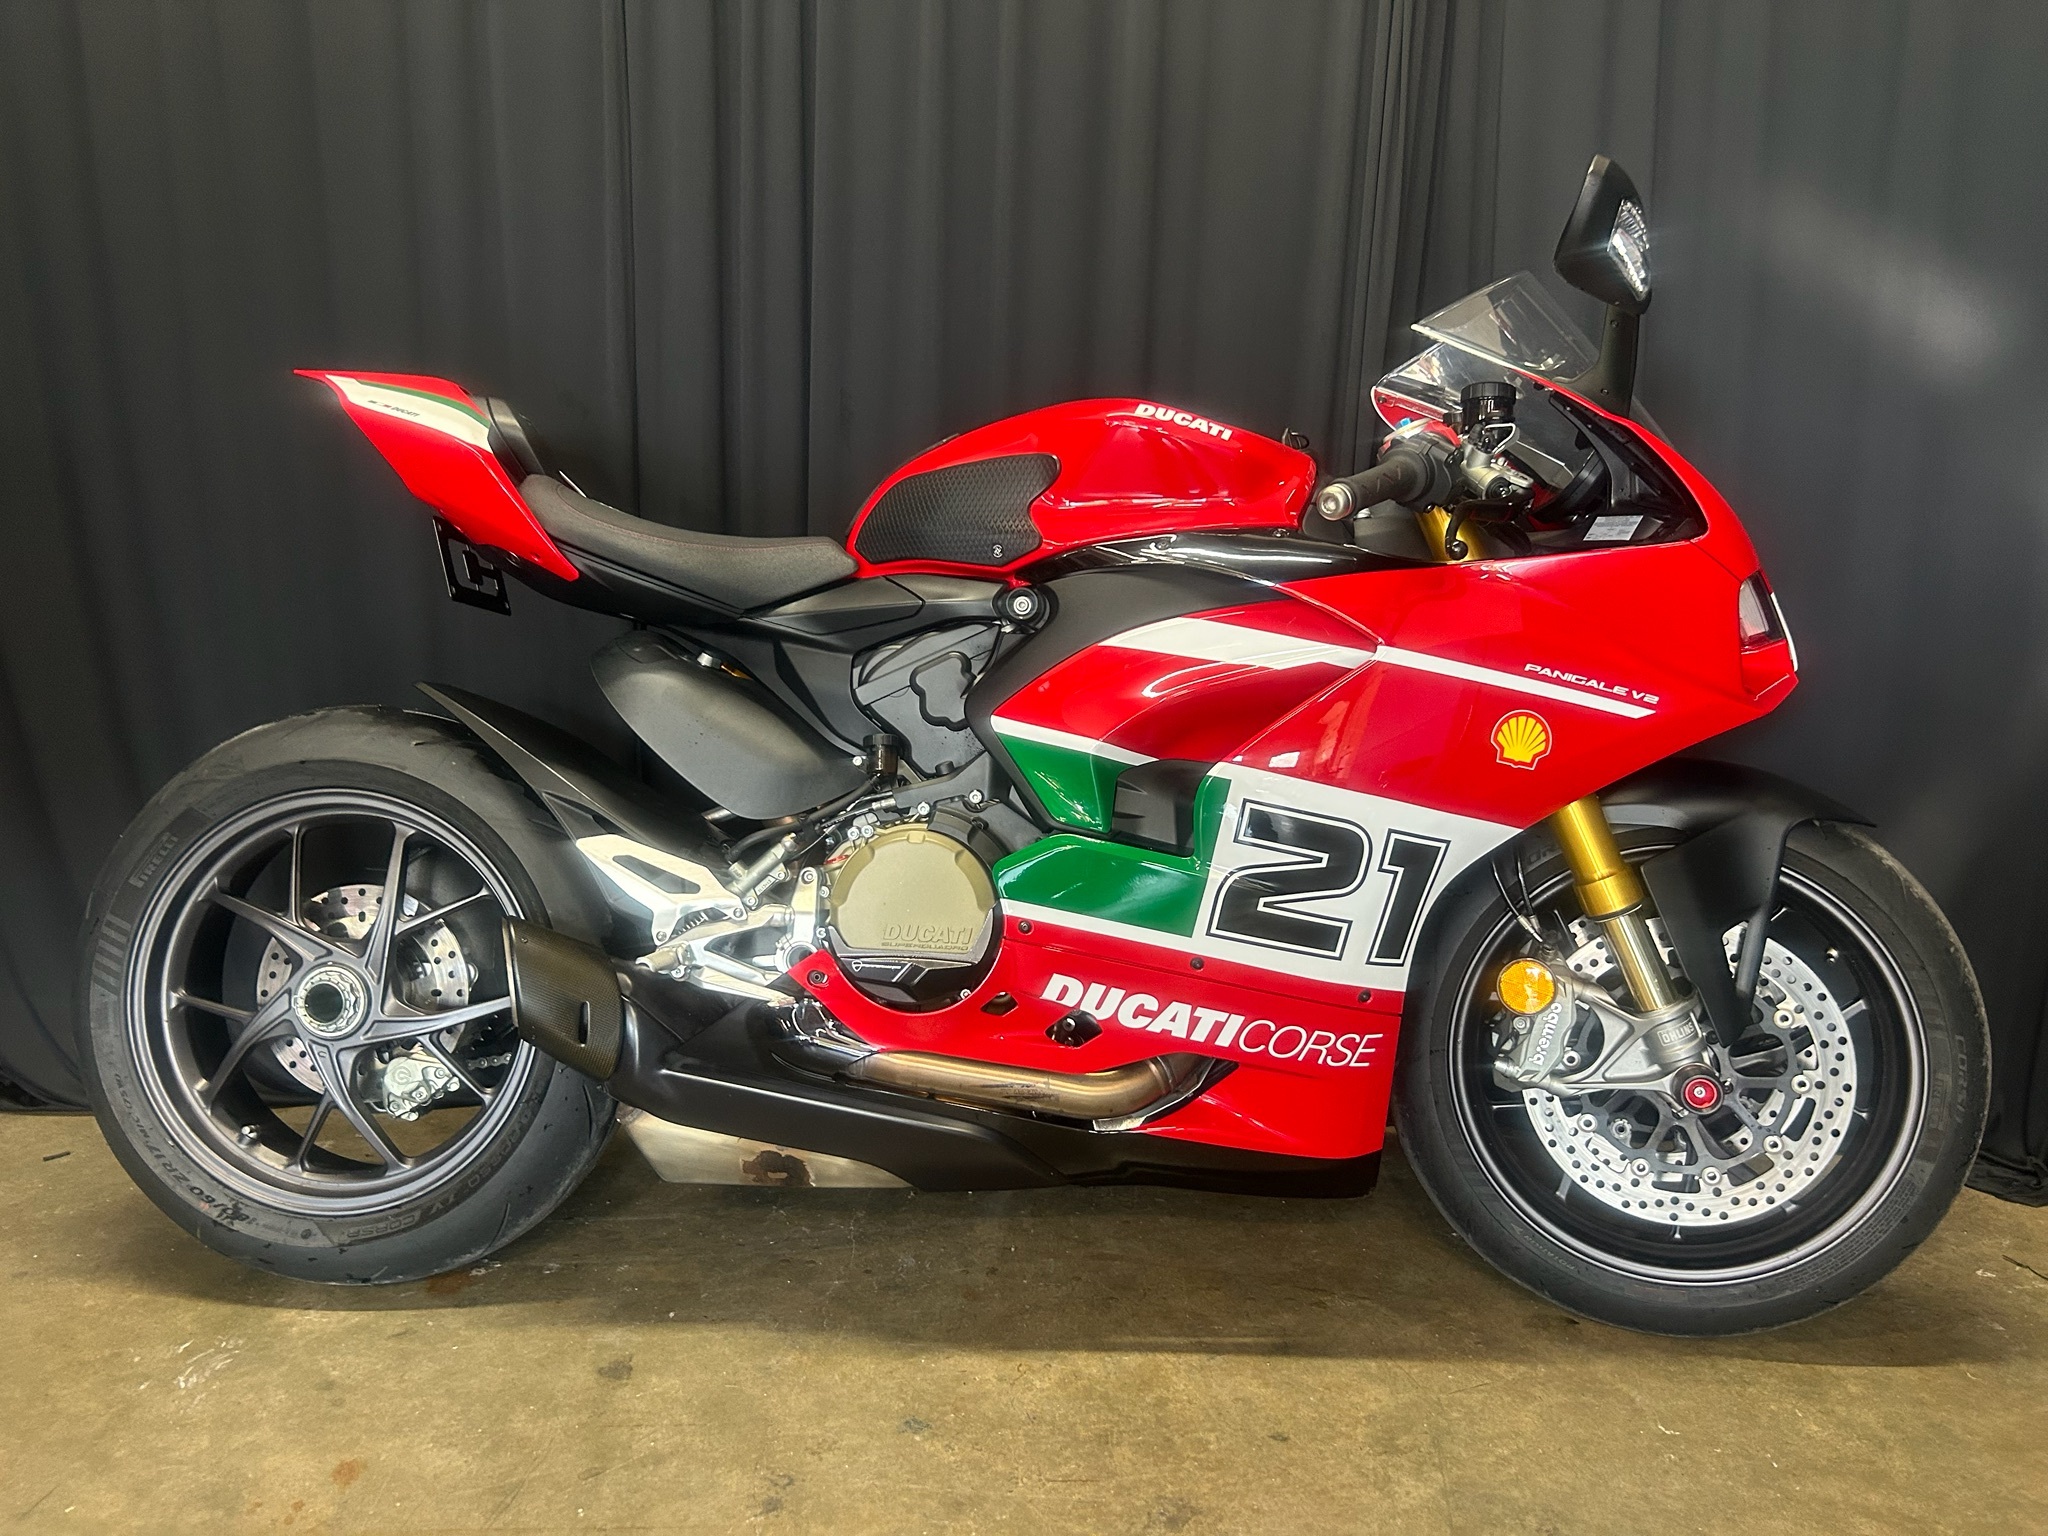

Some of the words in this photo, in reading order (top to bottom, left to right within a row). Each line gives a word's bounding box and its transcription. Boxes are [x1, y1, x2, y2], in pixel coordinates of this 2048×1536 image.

[1134, 403, 1233, 441] DUCATI
[1524, 663, 1629, 696] PANIGALE
[1631, 690, 1660, 704] V2
[128, 832, 179, 888] PIRELLI
[1205, 797, 1452, 967] 21
[882, 923, 974, 945] DUCATI
[1529, 1002, 1563, 1065] brembo
